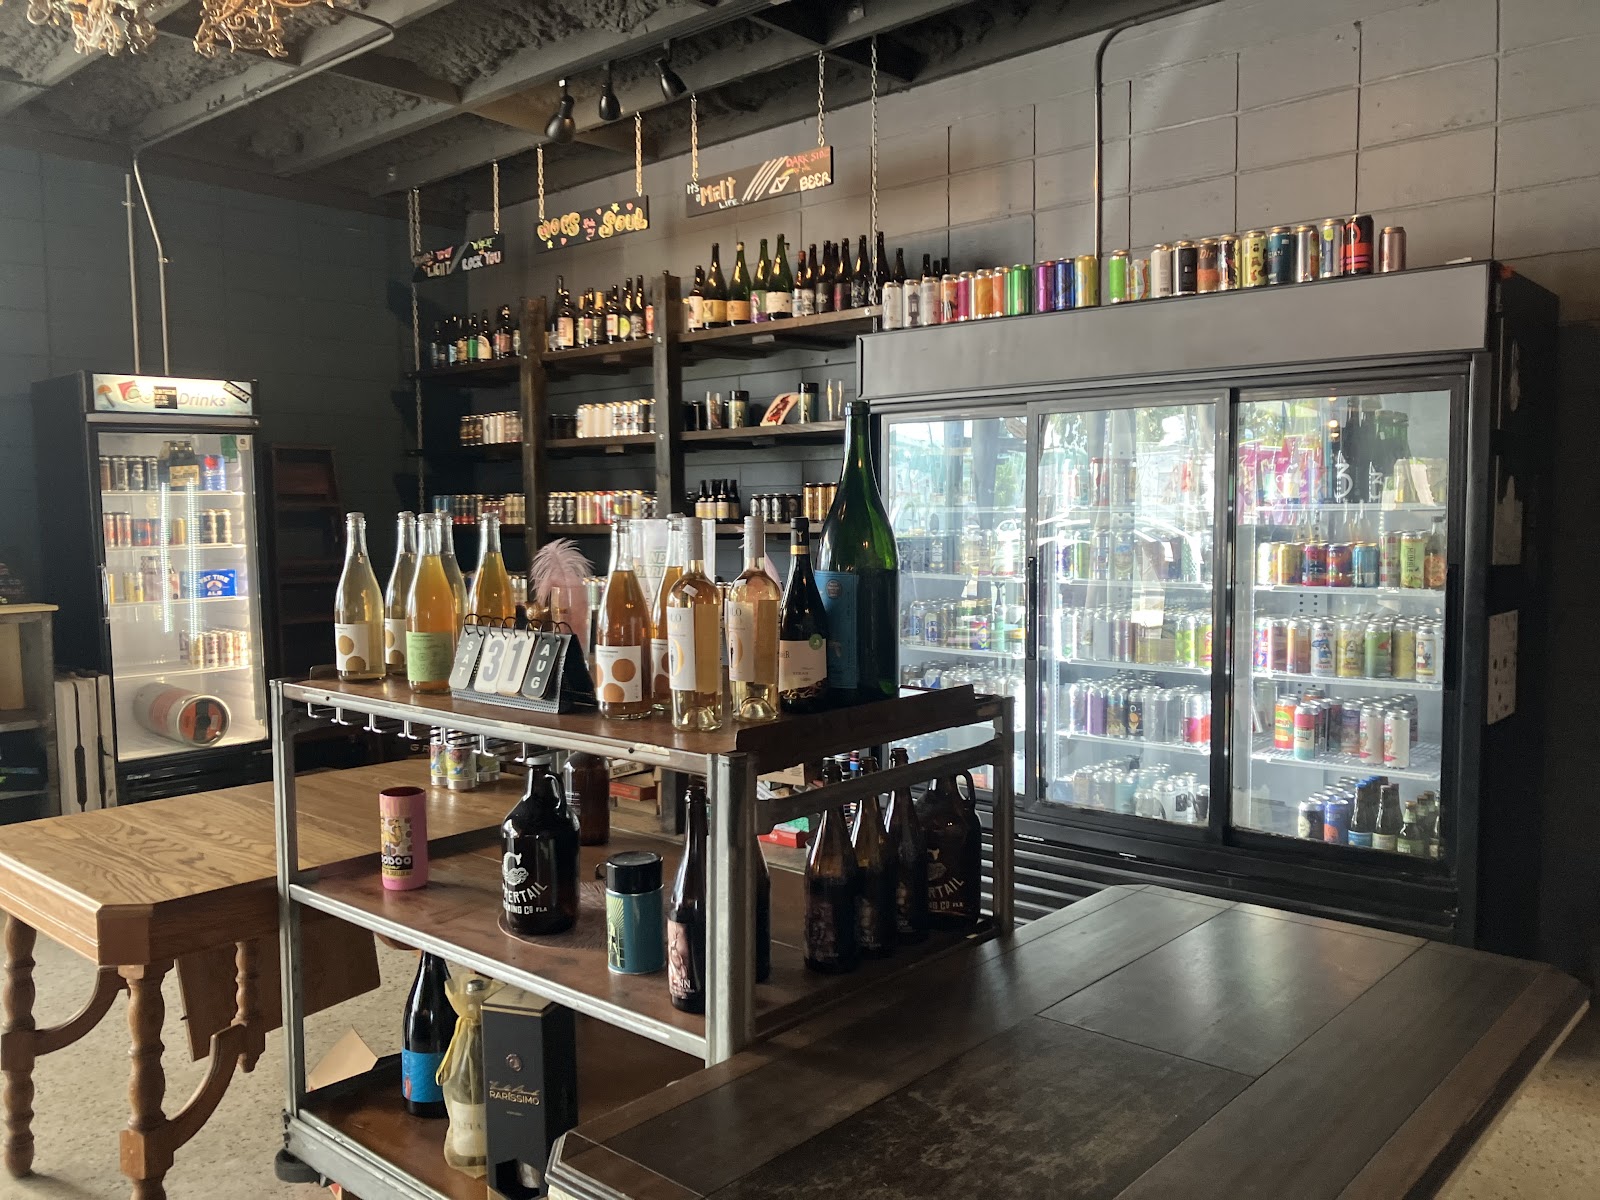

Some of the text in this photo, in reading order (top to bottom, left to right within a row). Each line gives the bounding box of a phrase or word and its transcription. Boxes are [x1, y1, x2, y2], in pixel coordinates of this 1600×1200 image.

[800, 172, 831, 191] BEER
[178, 392, 226, 408] Drinks
[459, 640, 475, 677] SAT
[530, 643, 550, 689] AUG
